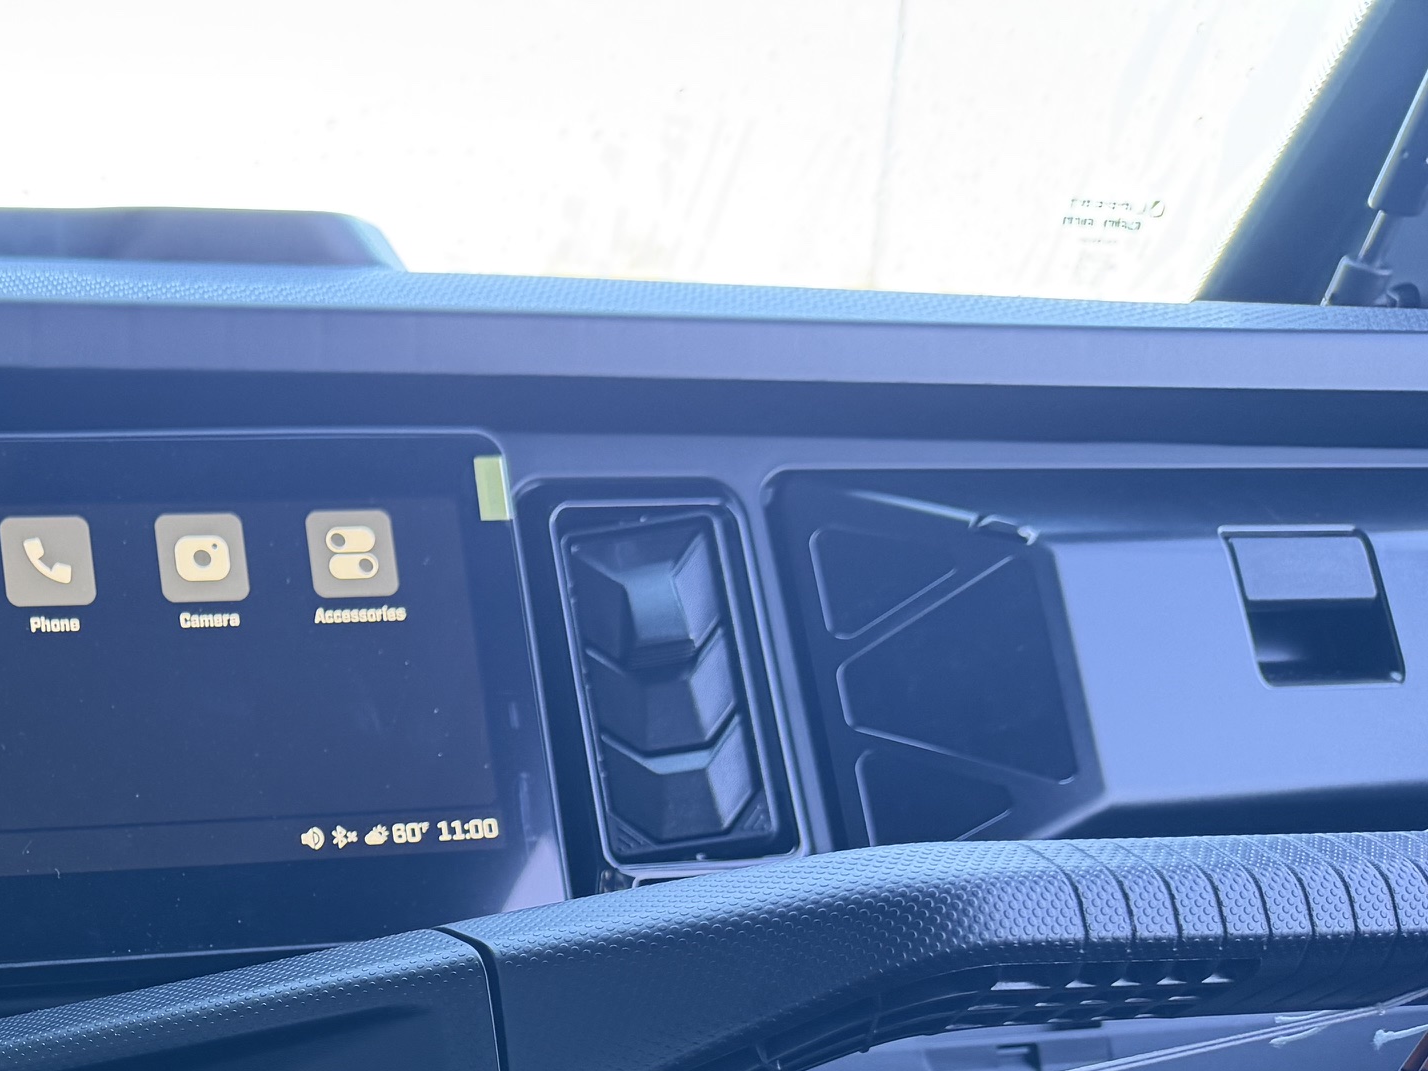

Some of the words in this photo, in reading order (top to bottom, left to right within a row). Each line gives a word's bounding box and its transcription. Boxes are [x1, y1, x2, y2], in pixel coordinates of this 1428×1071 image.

[179, 612, 240, 629] Camera
[314, 606, 406, 624] Accessories
[30, 616, 80, 633] Phone
[437, 818, 499, 841] 11:00
